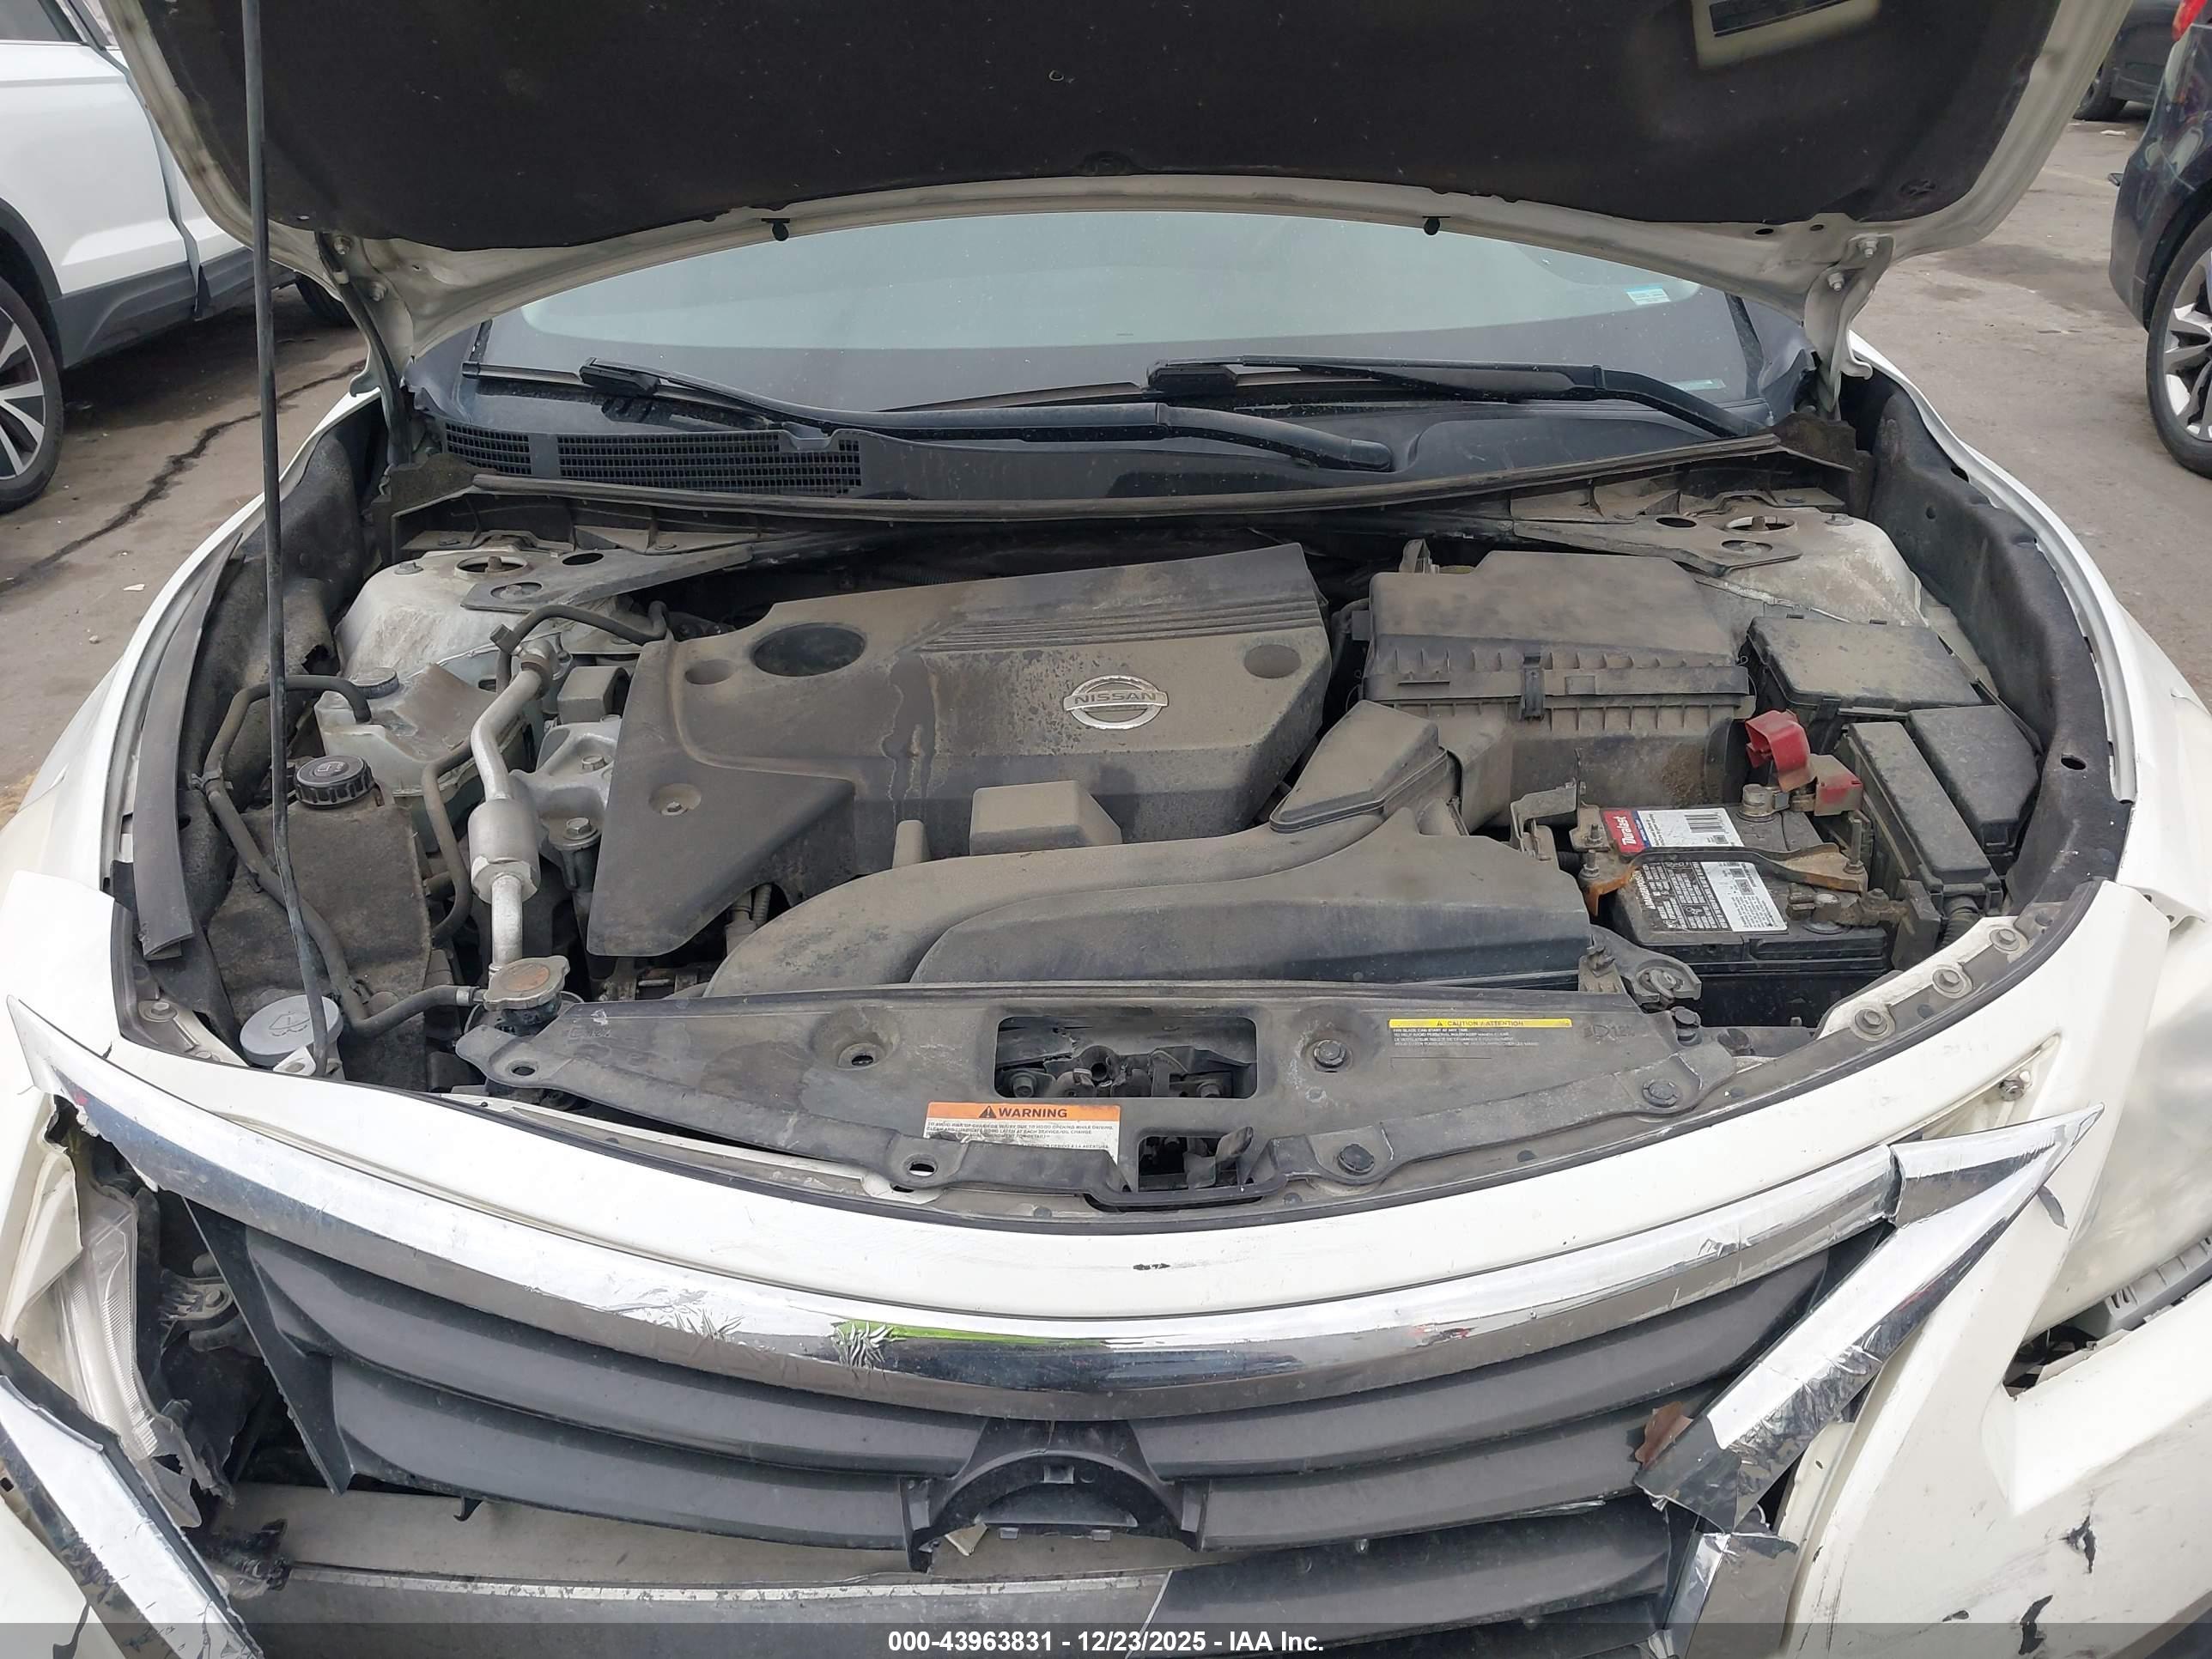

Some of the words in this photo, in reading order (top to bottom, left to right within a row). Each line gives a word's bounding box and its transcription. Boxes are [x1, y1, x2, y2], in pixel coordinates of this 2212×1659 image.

[1074, 692, 1156, 704] NISSAN
[1613, 816, 1637, 846] Duralast
[999, 1108, 1067, 1118] WARNING
